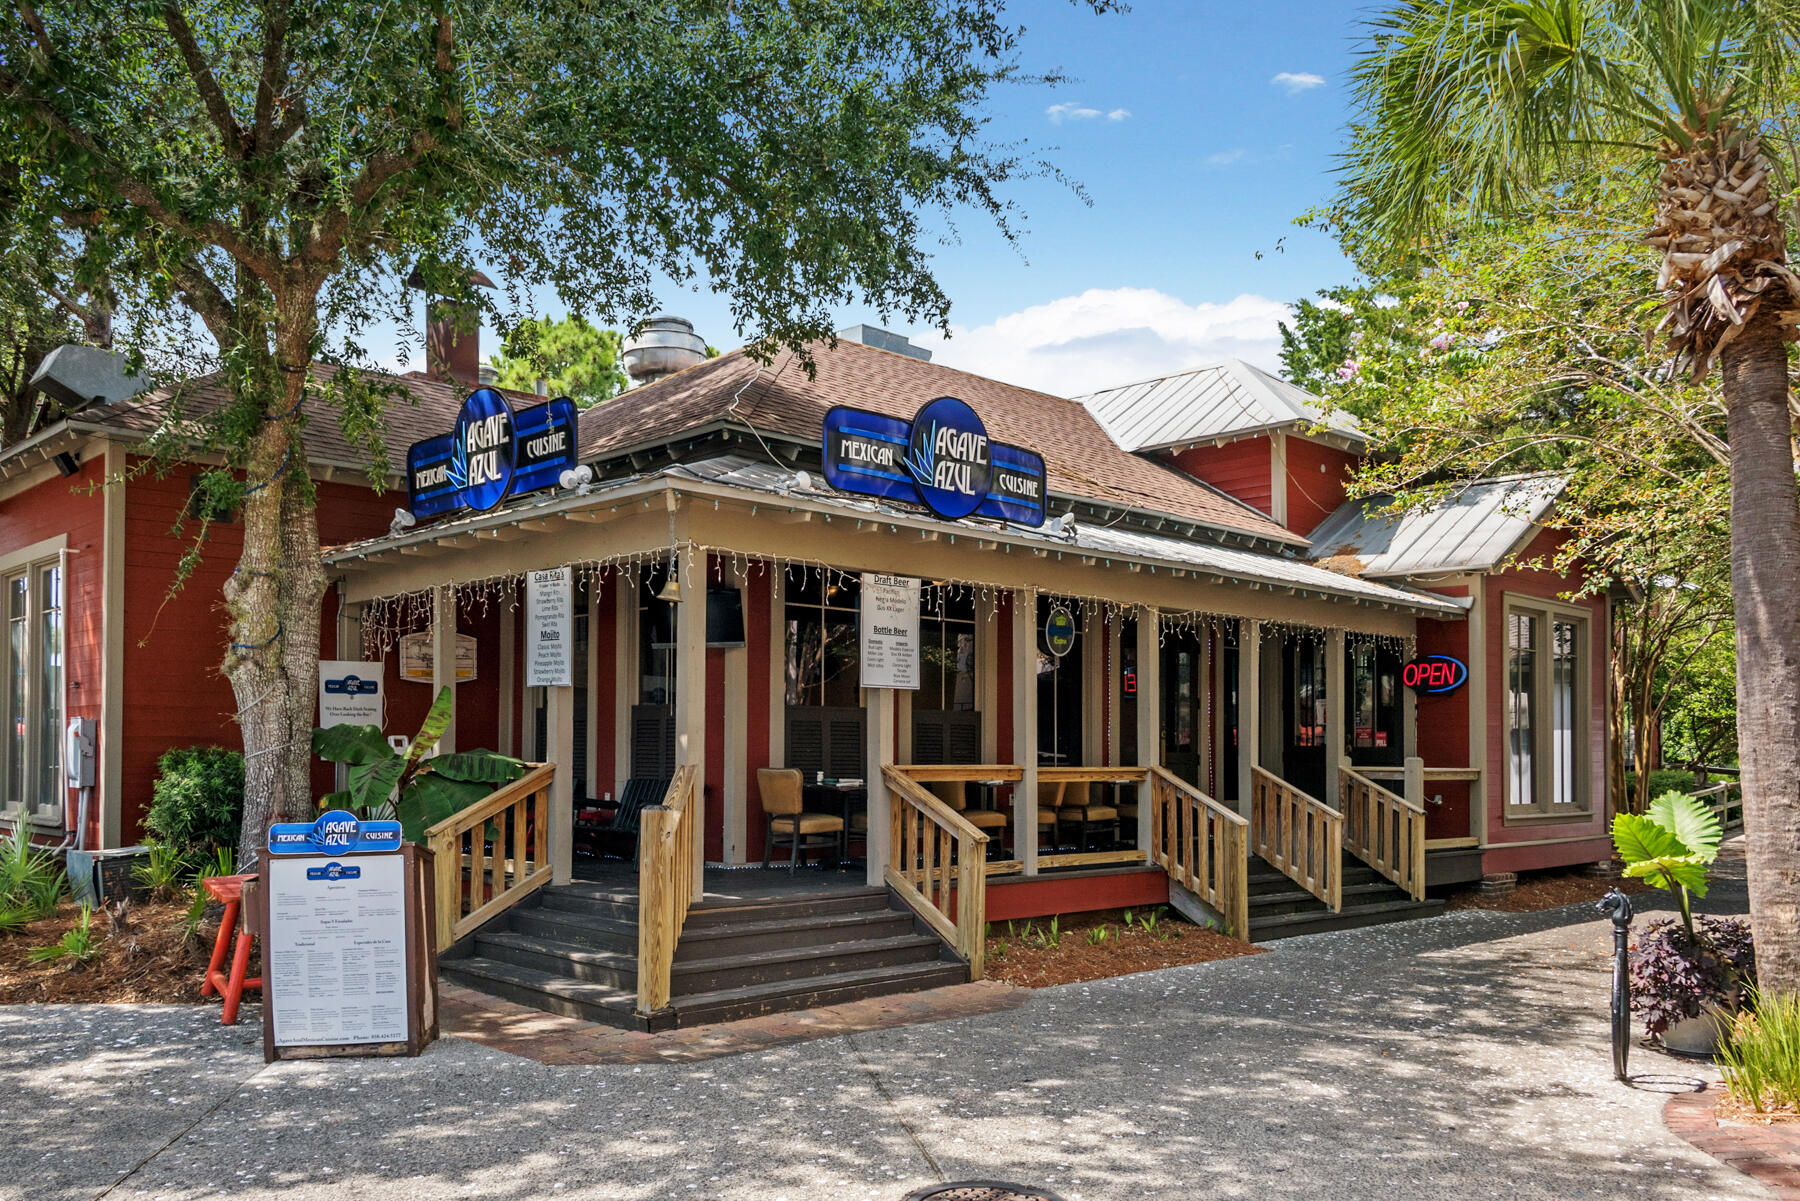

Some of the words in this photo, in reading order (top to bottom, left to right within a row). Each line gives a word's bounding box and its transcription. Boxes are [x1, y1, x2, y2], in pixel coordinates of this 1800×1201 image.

[467, 412, 510, 452] AGAVE
[526, 431, 566, 459] CUISINE
[840, 439, 893, 466] MEXICAN
[934, 426, 987, 465] AGAVE
[415, 464, 448, 490] MEXICAN
[468, 450, 502, 486] AZUL
[934, 460, 976, 496] AZUL
[999, 473, 1038, 498] CUISINE
[534, 572, 548, 580] Casa
[874, 574, 891, 584] Draft
[894, 576, 909, 585] Beer
[541, 630, 560, 640] Mojito
[874, 626, 892, 634] Bottle
[894, 627, 908, 635] Beer
[1402, 662, 1456, 686] OPEN
[325, 821, 357, 834] AGAVE
[325, 833, 350, 846] AZUL
[366, 832, 393, 840] CUISINE
